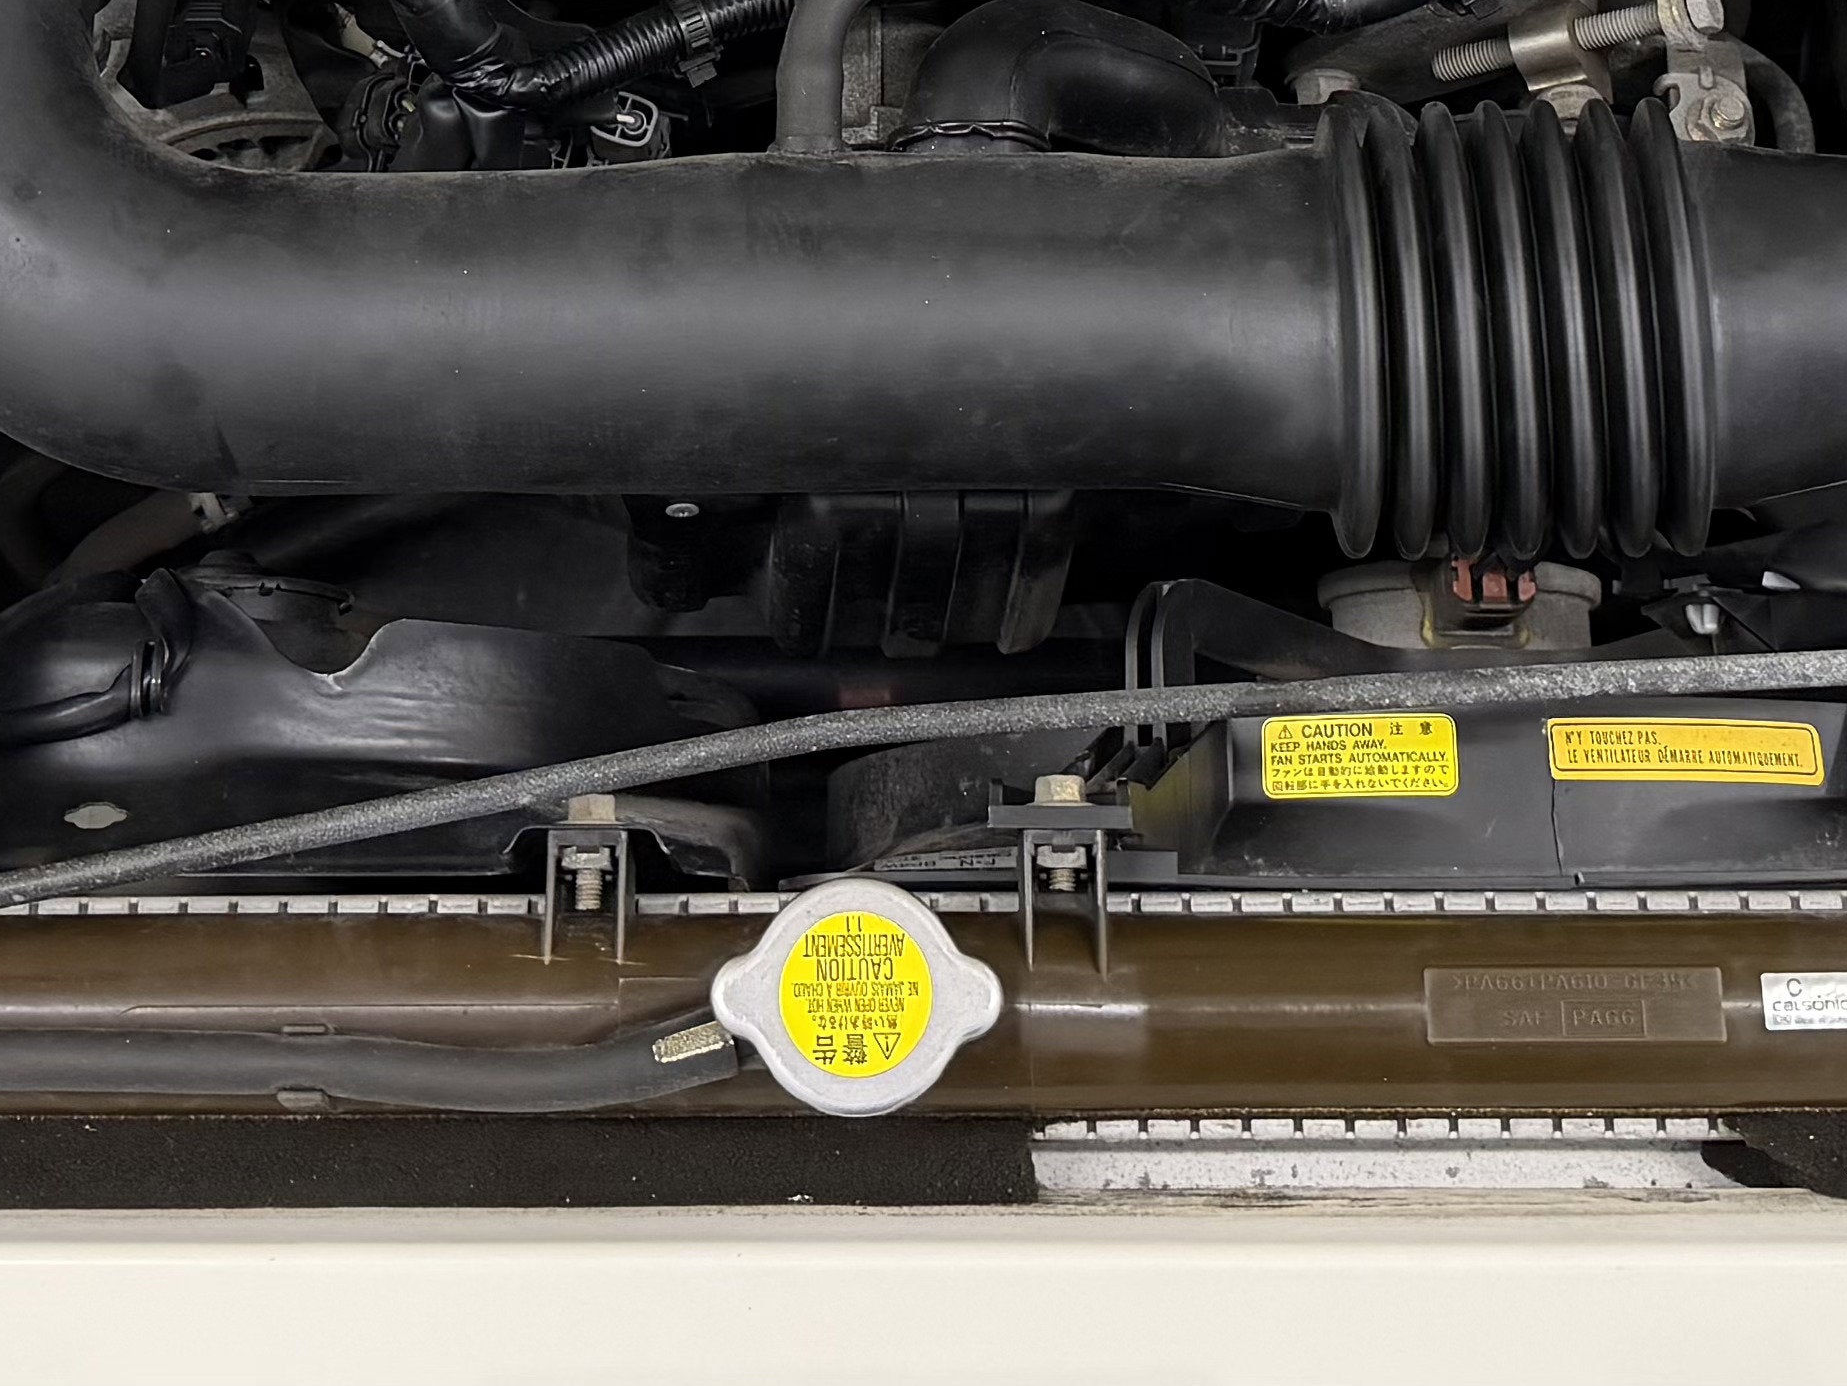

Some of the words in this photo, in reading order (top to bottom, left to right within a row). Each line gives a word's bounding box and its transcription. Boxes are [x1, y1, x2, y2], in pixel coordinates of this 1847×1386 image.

[1301, 723, 1373, 739] CAUTION
[1389, 722, 1434, 737] 注意
[1271, 740, 1301, 752] KEEP
[1305, 739, 1347, 752] HANDS
[1352, 739, 1388, 752] AWAY.
[1589, 731, 1634, 745] TOUCHEZ
[1638, 732, 1662, 745] PAS.
[1271, 754, 1292, 765] FAN
[1298, 753, 1342, 765] STARTS
[1348, 752, 1449, 766] AUTOMATICALLY.
[1567, 749, 1579, 763] LE
[1583, 749, 1651, 765] VENTILATEUR
[1657, 745, 1705, 766] DÉMARRE
[1708, 750, 1804, 768] AUTOMATIQUEMENT.
[803, 934, 905, 958] AVERTISSEMENT
[816, 957, 894, 982] CAUTION
[807, 998, 824, 1012] HOT.
[827, 998, 851, 1013] WHEN
[855, 998, 876, 1012] OPEN
[878, 998, 904, 1013] NEVER
[1572, 1008, 1635, 1027] PA66
[813, 1034, 868, 1065] 警告
